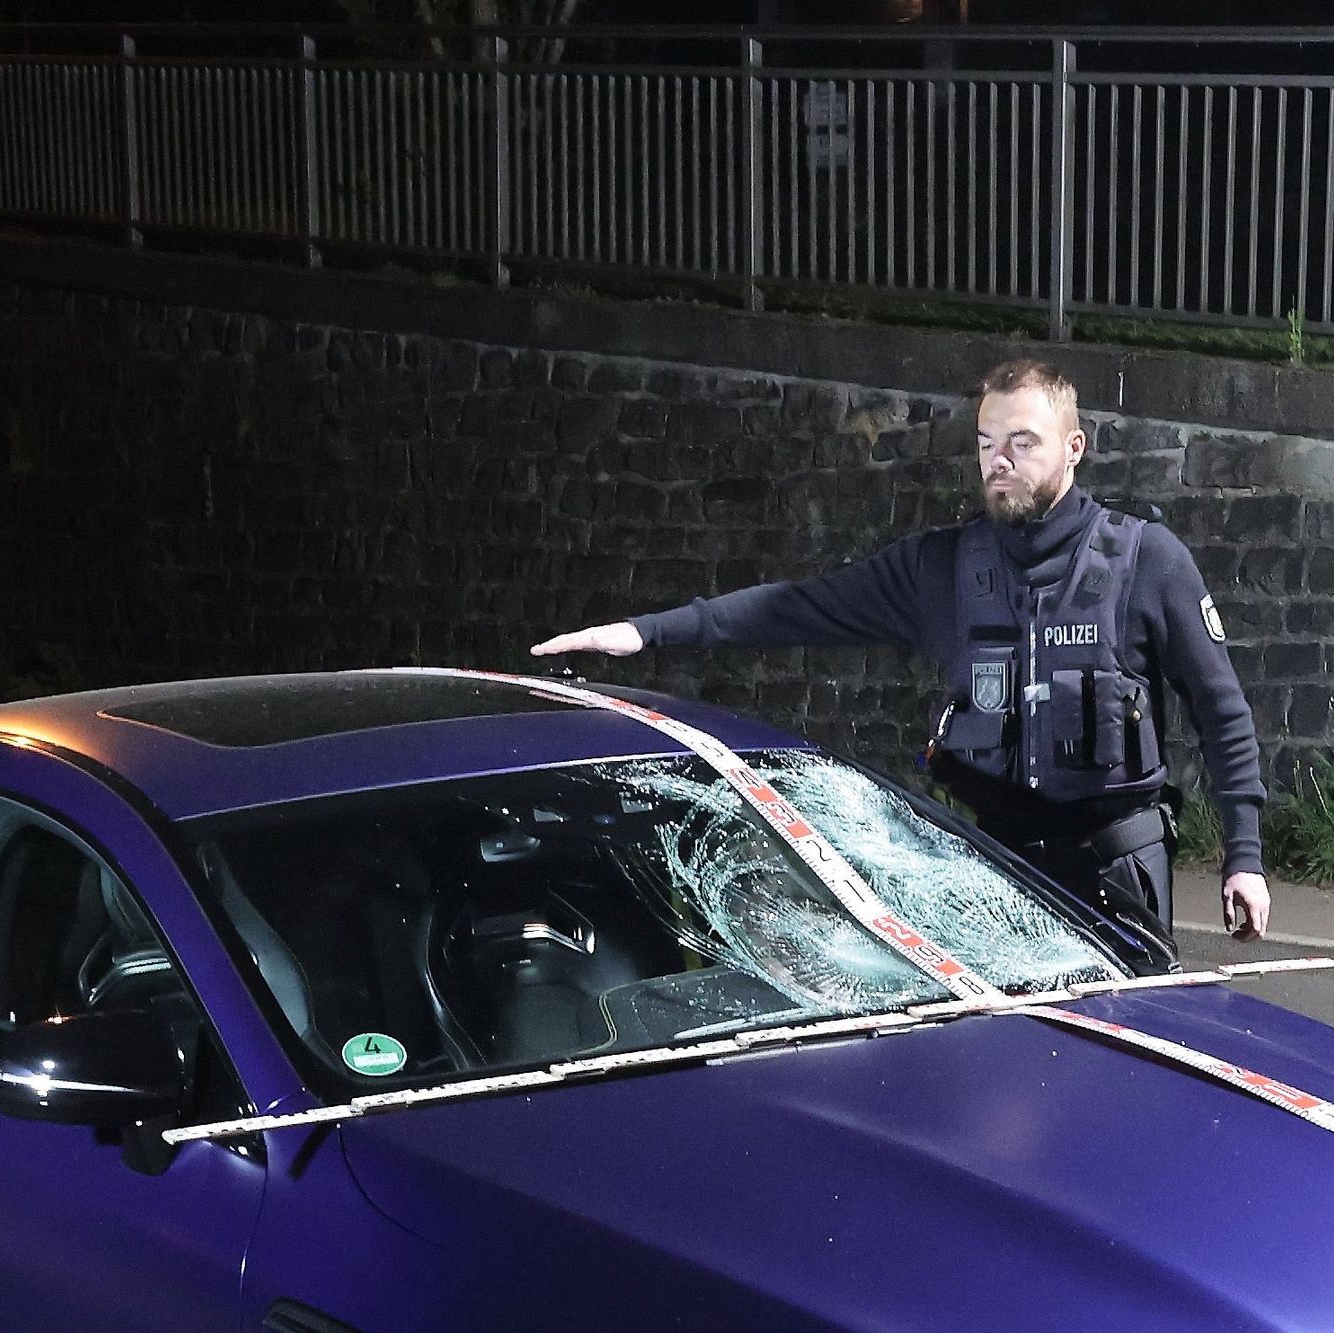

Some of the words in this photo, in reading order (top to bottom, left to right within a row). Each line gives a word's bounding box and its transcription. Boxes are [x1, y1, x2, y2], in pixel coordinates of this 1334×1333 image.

[1044, 624, 1098, 647] POLIZEI
[958, 975, 986, 996] 8
[365, 1036, 382, 1054] 4
